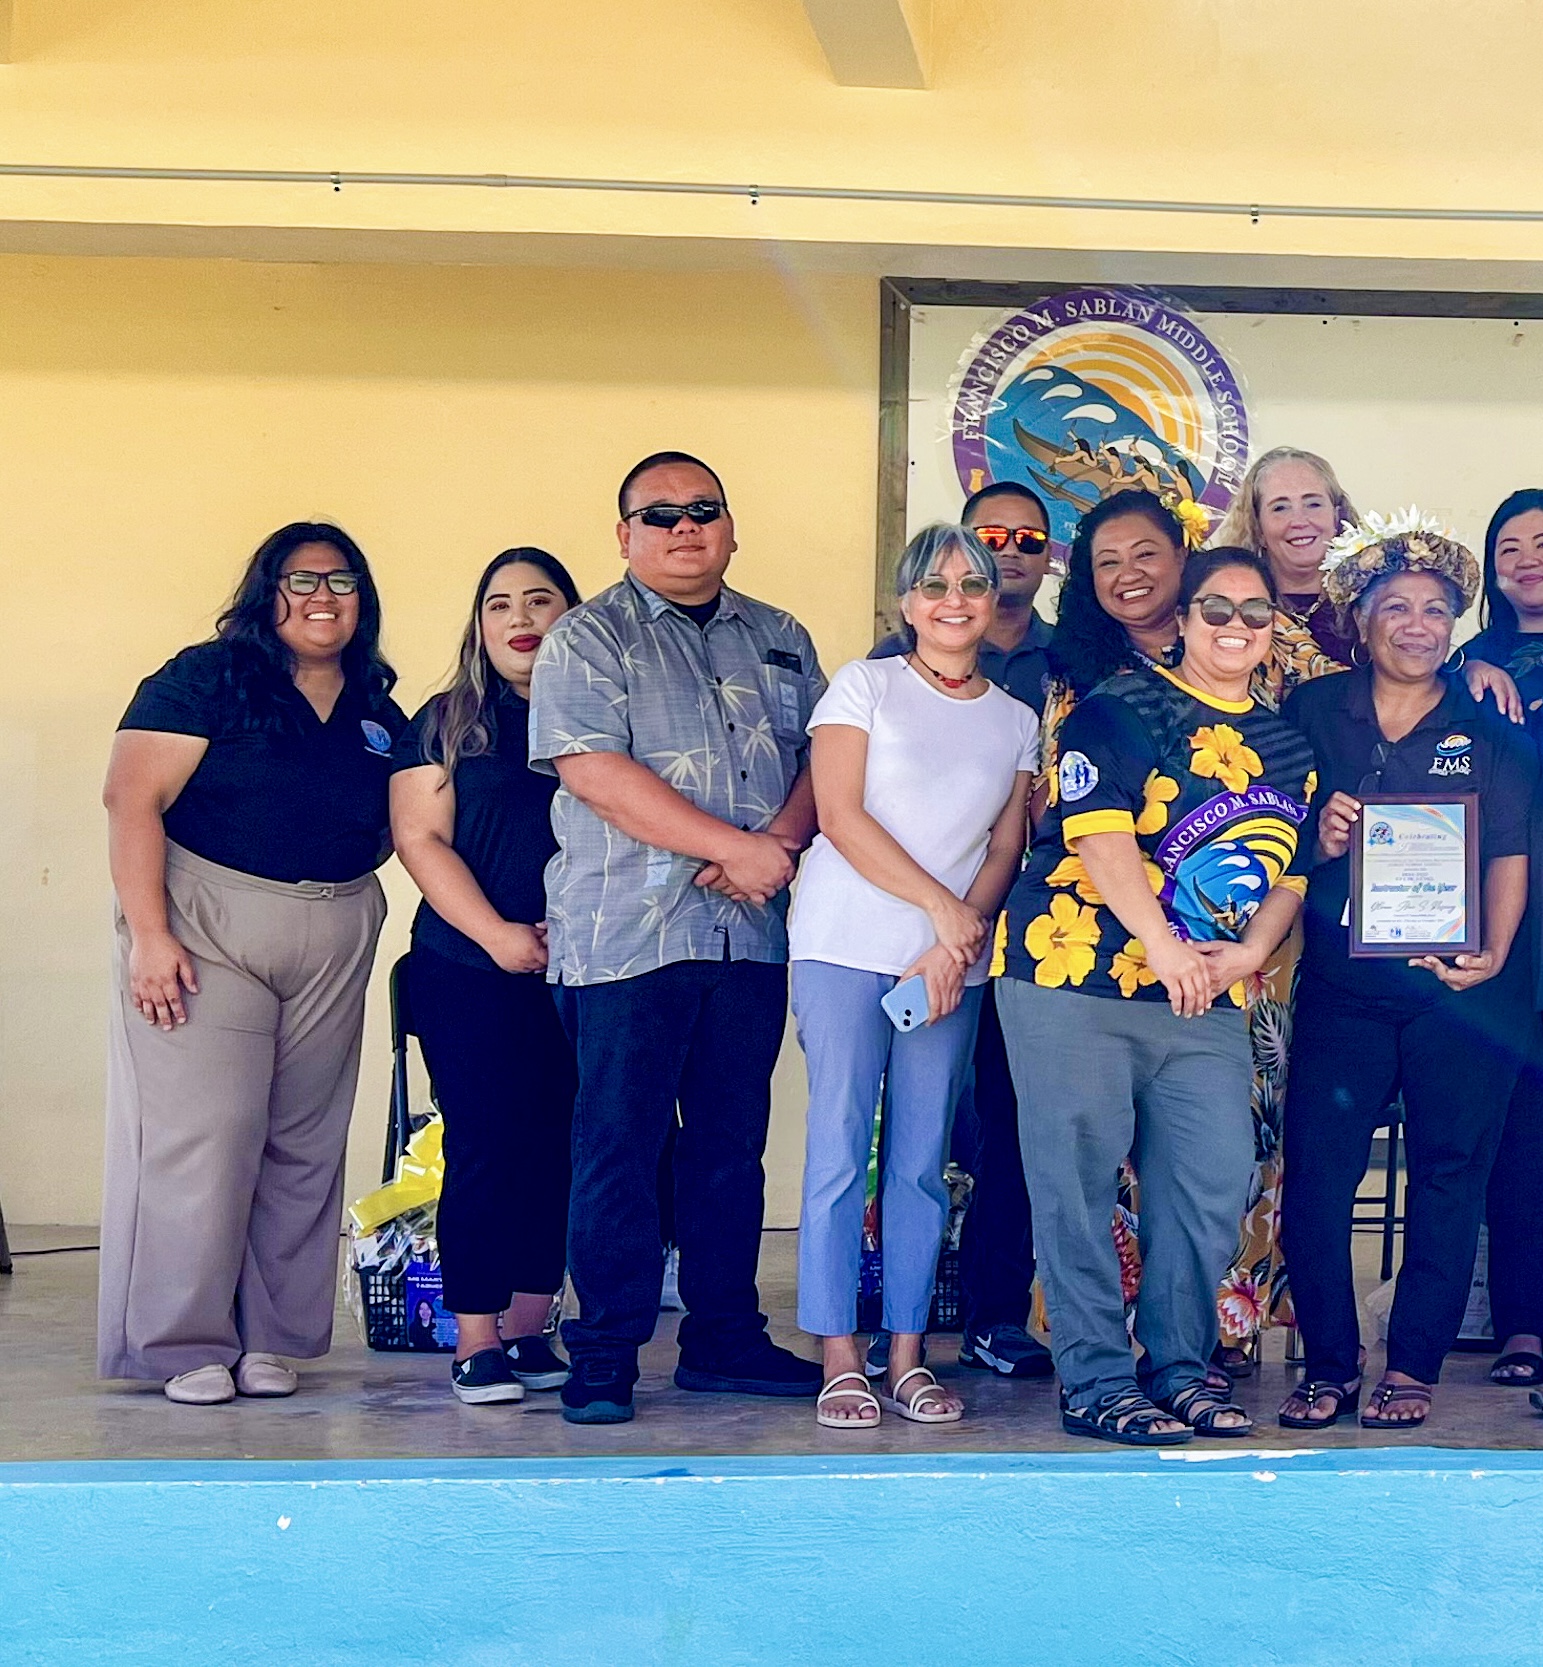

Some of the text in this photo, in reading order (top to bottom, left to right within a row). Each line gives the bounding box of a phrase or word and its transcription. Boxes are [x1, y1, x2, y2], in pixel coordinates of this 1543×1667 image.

[962, 298, 1240, 487] FRANCISCO M. SABLAN MIDDLE SCHOOL
[1162, 791, 1298, 880] ANCISCO M. SABLAN
